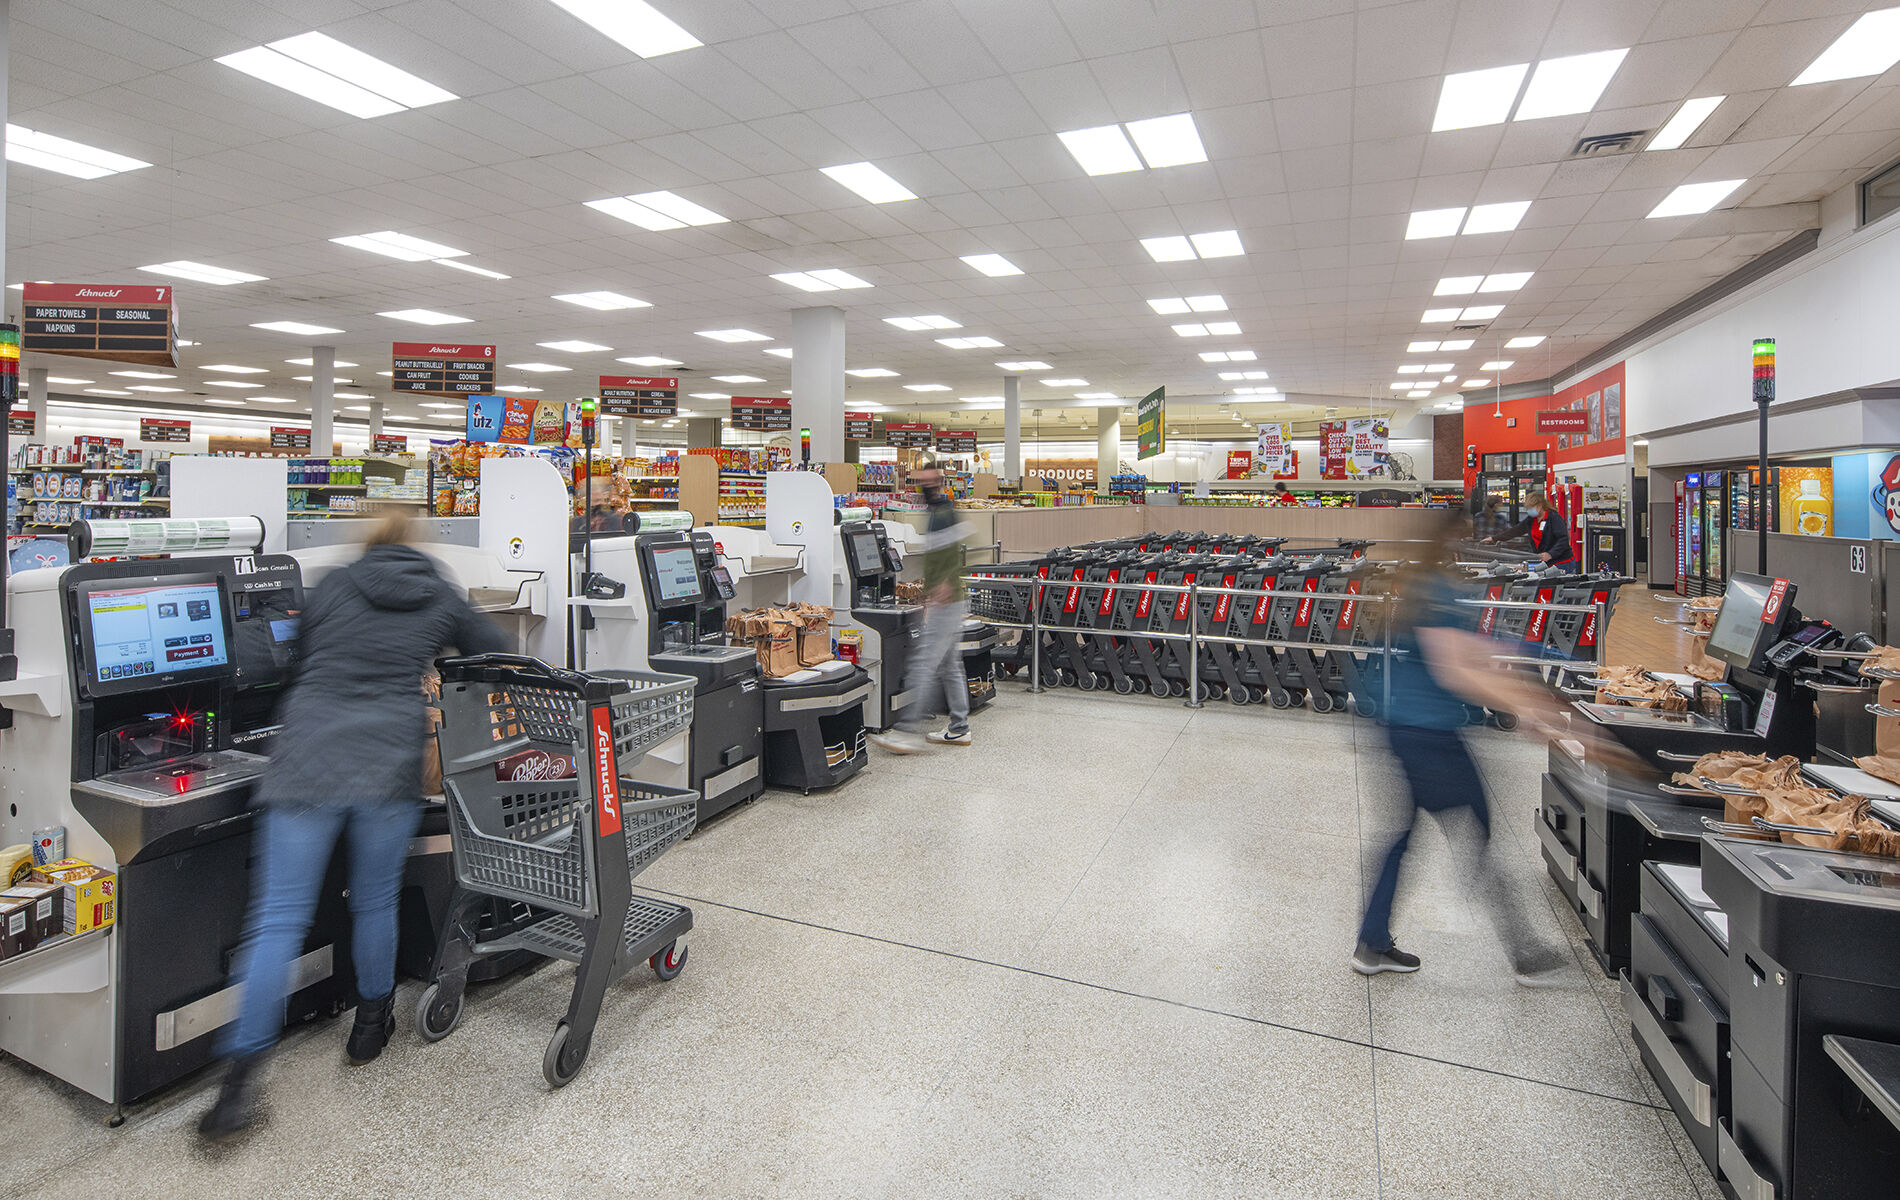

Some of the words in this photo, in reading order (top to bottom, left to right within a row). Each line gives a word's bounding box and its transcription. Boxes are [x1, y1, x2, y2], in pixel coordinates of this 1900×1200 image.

[75, 288, 122, 299] Schnucks
[155, 288, 166, 301] 7
[36, 308, 58, 318] PAPER
[58, 309, 86, 319] TOWELS
[116, 310, 150, 320] SEASONAL
[45, 323, 76, 334] NAPKINS
[484, 346, 492, 356] 6
[395, 360, 413, 368] PEANUT
[458, 373, 479, 381] COOKIES
[456, 384, 481, 392] CRACKERS
[669, 379, 676, 387] 5
[1029, 469, 1093, 480] PRODUCE
[1852, 546, 1865, 572] 63
[235, 557, 254, 574] 71
[174, 650, 199, 658] Payment
[244, 734, 256, 742] Coin
[525, 756, 539, 771] Dr
[597, 725, 616, 818] Schnucks
